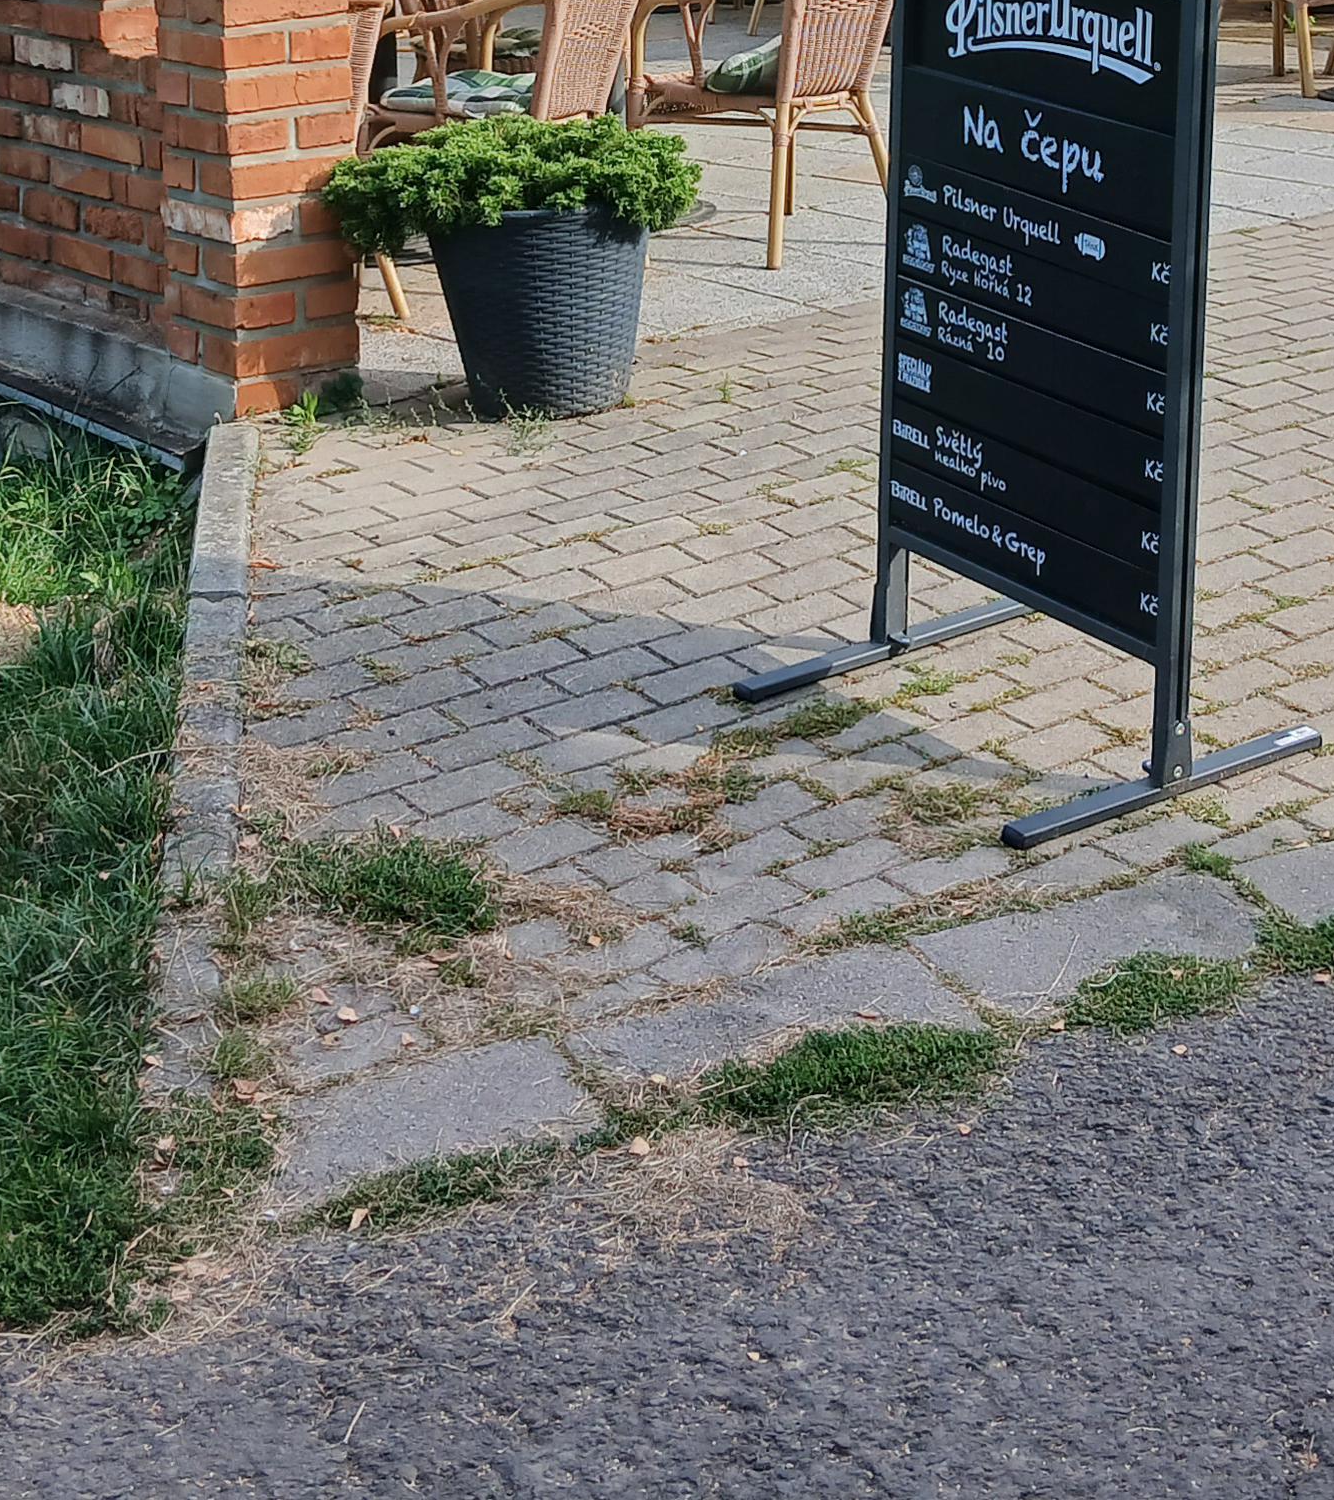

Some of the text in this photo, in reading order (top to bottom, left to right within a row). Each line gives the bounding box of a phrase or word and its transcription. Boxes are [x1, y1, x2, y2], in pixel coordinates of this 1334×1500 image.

[962, 104, 1105, 194] Na čepu
[942, 184, 997, 222] Pilsner
[1003, 206, 1061, 247] Urquell
[942, 235, 1014, 277] Radegast
[1151, 261, 1171, 284] Kč
[1016, 283, 1032, 306] 12
[938, 301, 1008, 345] Radegast
[1150, 322, 1169, 345] Kč
[937, 326, 974, 353] Rázná
[987, 341, 1005, 362] 10
[1146, 391, 1165, 415] Kč
[935, 425, 983, 469] Světlý
[934, 450, 1006, 492] nealko pivo
[1144, 458, 1164, 482] Kč
[933, 497, 990, 539] Pomelo
[991, 524, 1002, 548] &
[1004, 531, 1046, 577] Grep
[1141, 530, 1160, 554] Kč
[1139, 591, 1159, 616] Kč
